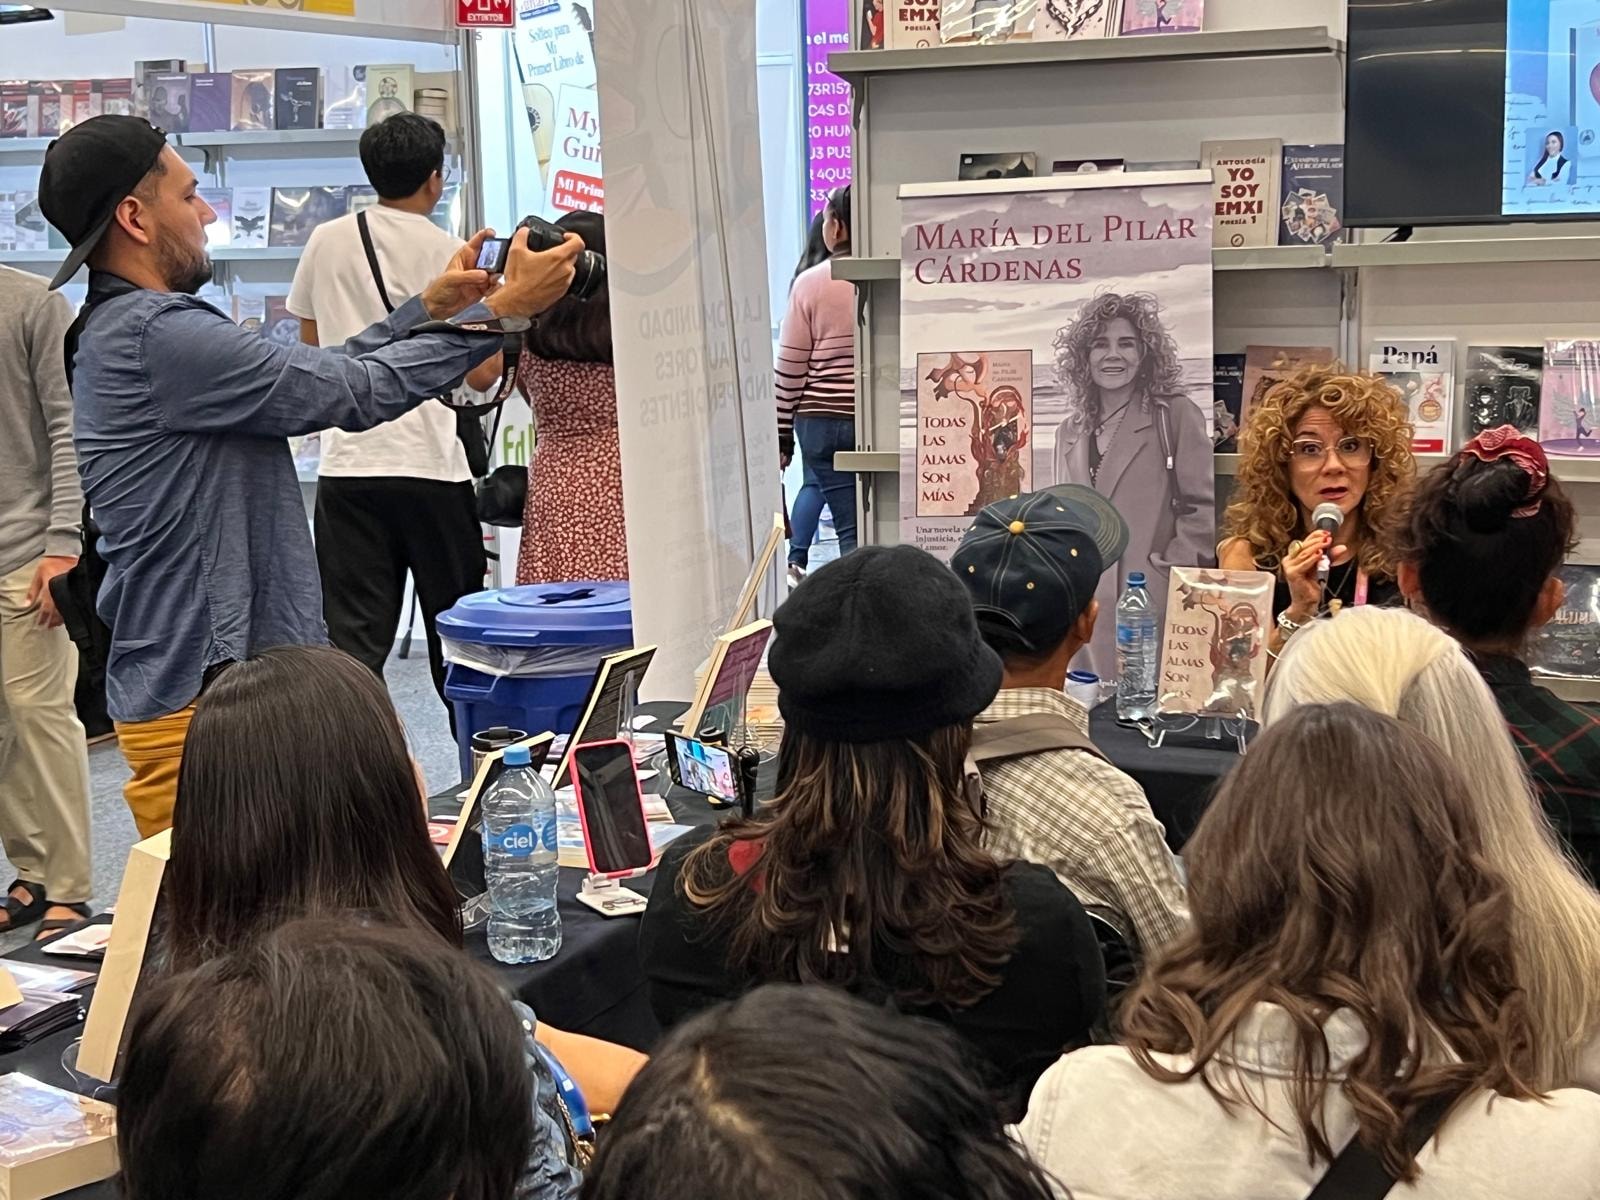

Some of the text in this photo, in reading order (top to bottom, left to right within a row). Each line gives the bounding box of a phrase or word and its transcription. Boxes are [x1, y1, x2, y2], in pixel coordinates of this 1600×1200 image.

[554, 24, 571, 39] para
[566, 107, 599, 138] My
[1216, 157, 1266, 166] ANTOLOGÍA
[1227, 167, 1255, 182] YO
[557, 177, 574, 192] Mi
[1221, 183, 1260, 199] SOY
[555, 192, 587, 211] Libro
[1215, 200, 1264, 216] EMXI
[1220, 215, 1257, 226] POESÍA 1
[1032, 223, 1092, 245] DEL
[1103, 215, 1197, 242] PILAR
[914, 256, 1083, 285] CÁRDENAS
[1382, 344, 1439, 370] Papá
[922, 416, 967, 428] TODAS
[923, 434, 946, 446] LAS
[921, 454, 967, 466] ALMAS
[921, 471, 950, 484] SON
[921, 487, 955, 502] MÍAS
[916, 524, 961, 534] Una novela
[1172, 623, 1209, 636] TODAS
[1168, 639, 1190, 651] LAS
[1165, 656, 1205, 668] ALMAS
[1164, 670, 1190, 683] SON
[503, 831, 533, 849] ciel
